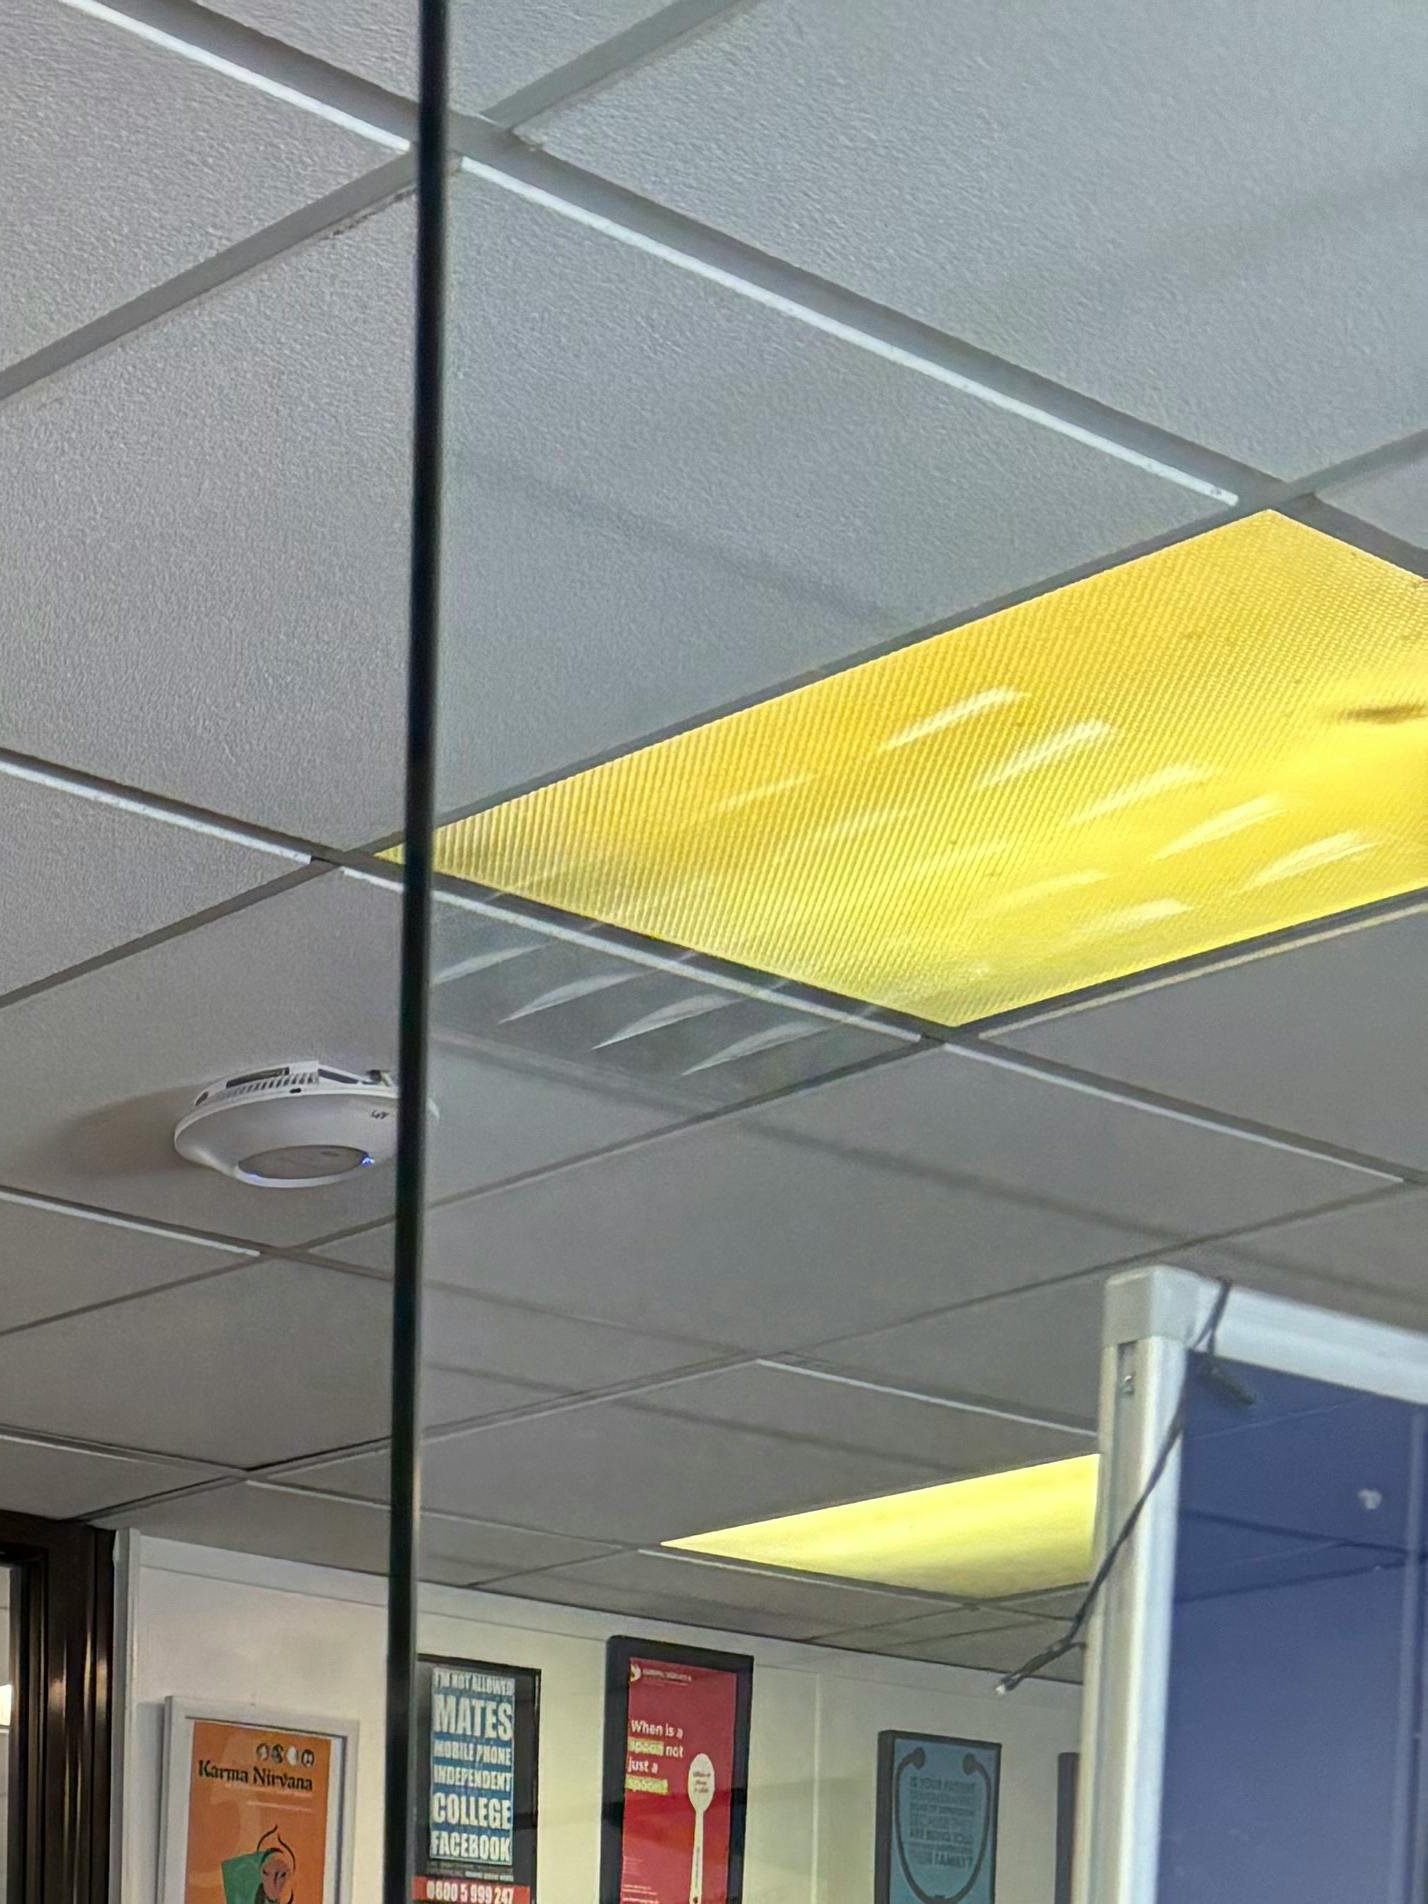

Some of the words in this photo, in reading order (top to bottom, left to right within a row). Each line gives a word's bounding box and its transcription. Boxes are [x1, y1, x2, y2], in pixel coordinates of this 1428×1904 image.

[433, 1694, 513, 1741] MATES
[631, 1719, 663, 1736] When
[665, 1722, 674, 1737] is
[676, 1728, 683, 1739] a
[433, 1739, 475, 1761] MOBILE
[476, 1744, 512, 1766] PHONE
[628, 1755, 649, 1773] just
[651, 1762, 658, 1774] a
[665, 1745, 683, 1758] not
[198, 1759, 248, 1783] Karma
[253, 1766, 313, 1791] Nirvana
[433, 1765, 512, 1792] INDEPENDENT
[432, 1792, 511, 1829] COLLEGE
[430, 1830, 510, 1861] FACEBOOK
[426, 1880, 458, 1902] 0800
[460, 1883, 469, 1903] 5
[470, 1883, 493, 1904] 999
